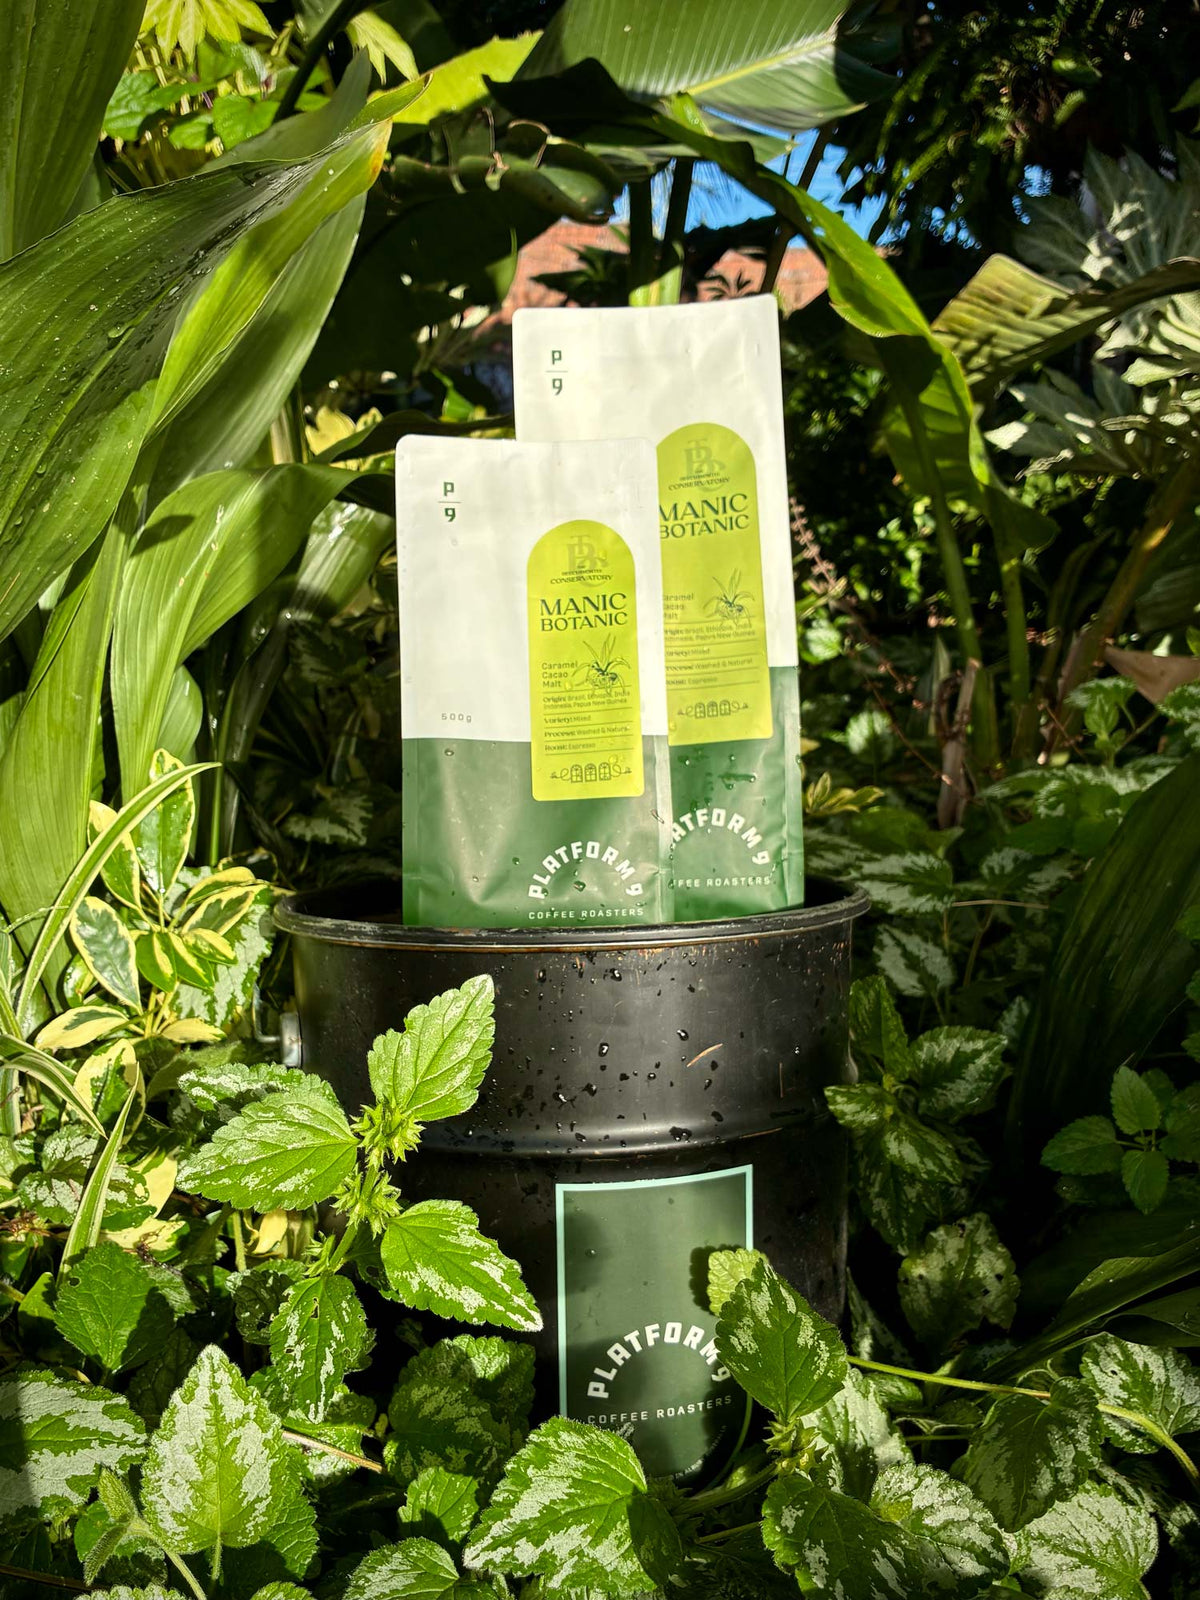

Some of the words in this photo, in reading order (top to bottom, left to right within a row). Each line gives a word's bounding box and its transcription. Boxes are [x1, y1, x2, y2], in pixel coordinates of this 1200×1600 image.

[552, 378, 563, 396] 9
[668, 477, 731, 491] CONSERVATORY
[444, 507, 456, 522] 9
[659, 493, 749, 522] MANIC
[660, 514, 750, 539] BOTANIC
[550, 574, 613, 585] CONSERVATORY
[540, 592, 627, 616] MANIC
[663, 593, 694, 601] aramel
[541, 611, 628, 632] BOTANIC
[541, 661, 578, 671] Caramel
[542, 671, 568, 680] Cacao
[543, 680, 561, 688] Malt
[441, 712, 472, 724] 500g
[568, 742, 596, 751] Espresso
[672, 808, 763, 849] ATFORM
[751, 850, 770, 865] 9
[528, 841, 636, 899] PLATFORM
[625, 882, 643, 896] 9
[706, 876, 770, 887] ROASTERS
[528, 910, 575, 919] COFFEE
[582, 908, 645, 918] ROASTERS
[587, 1321, 721, 1399] PLATFORM
[711, 1366, 731, 1382] 9
[587, 1410, 649, 1425] COFFEE
[656, 1395, 732, 1419] ROASTERS
